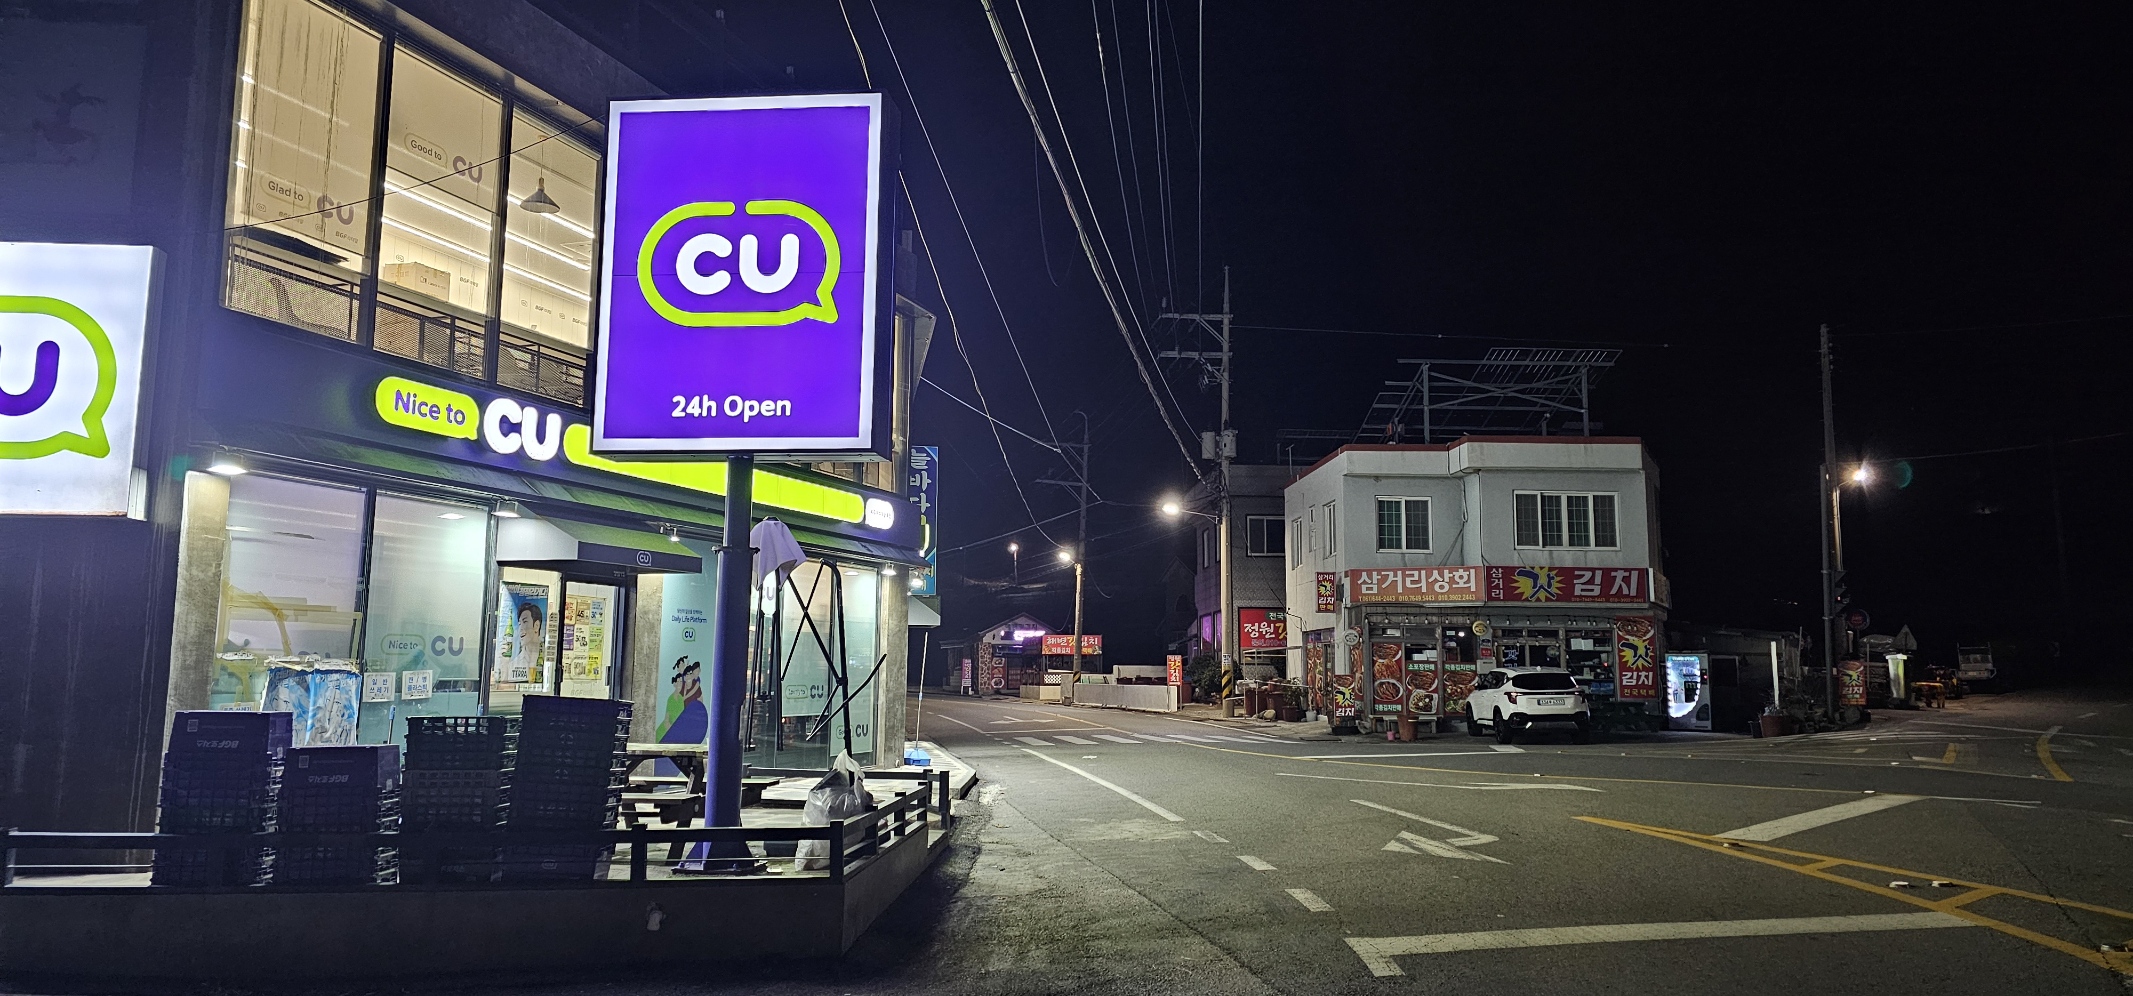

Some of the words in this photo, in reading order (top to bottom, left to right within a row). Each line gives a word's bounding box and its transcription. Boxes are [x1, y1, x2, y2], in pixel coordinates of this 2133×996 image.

[411, 139, 433, 158] Good
[433, 150, 442, 161] to
[452, 155, 483, 184] CU
[268, 180, 292, 197] Glad
[292, 186, 304, 202] to
[317, 195, 354, 226] CU
[675, 232, 800, 296] CU
[394, 389, 441, 421] Nice
[445, 403, 466, 426] to
[671, 394, 717, 418] 24h
[723, 395, 792, 423] Open
[483, 397, 562, 461] CU
[640, 554, 649, 563] CU
[1357, 568, 1476, 594] 삼거리상회
[1490, 567, 1504, 600] 삼거리
[1515, 567, 1558, 600] 갓
[1573, 569, 1639, 597] 김치
[1318, 596, 1335, 605] 김치
[671, 615, 682, 624] Daily
[690, 616, 708, 625] Platform
[388, 639, 408, 650] Nice
[409, 641, 418, 650] to
[684, 630, 694, 639] CU
[430, 635, 465, 657] CU
[1619, 640, 1653, 668] 갓
[511, 669, 528, 679] TERRA
[1622, 671, 1654, 686] 김치
[369, 686, 390, 694] 쓰레기
[810, 684, 824, 699] CU
[1335, 707, 1355, 717] 김치
[855, 723, 869, 738] CU
